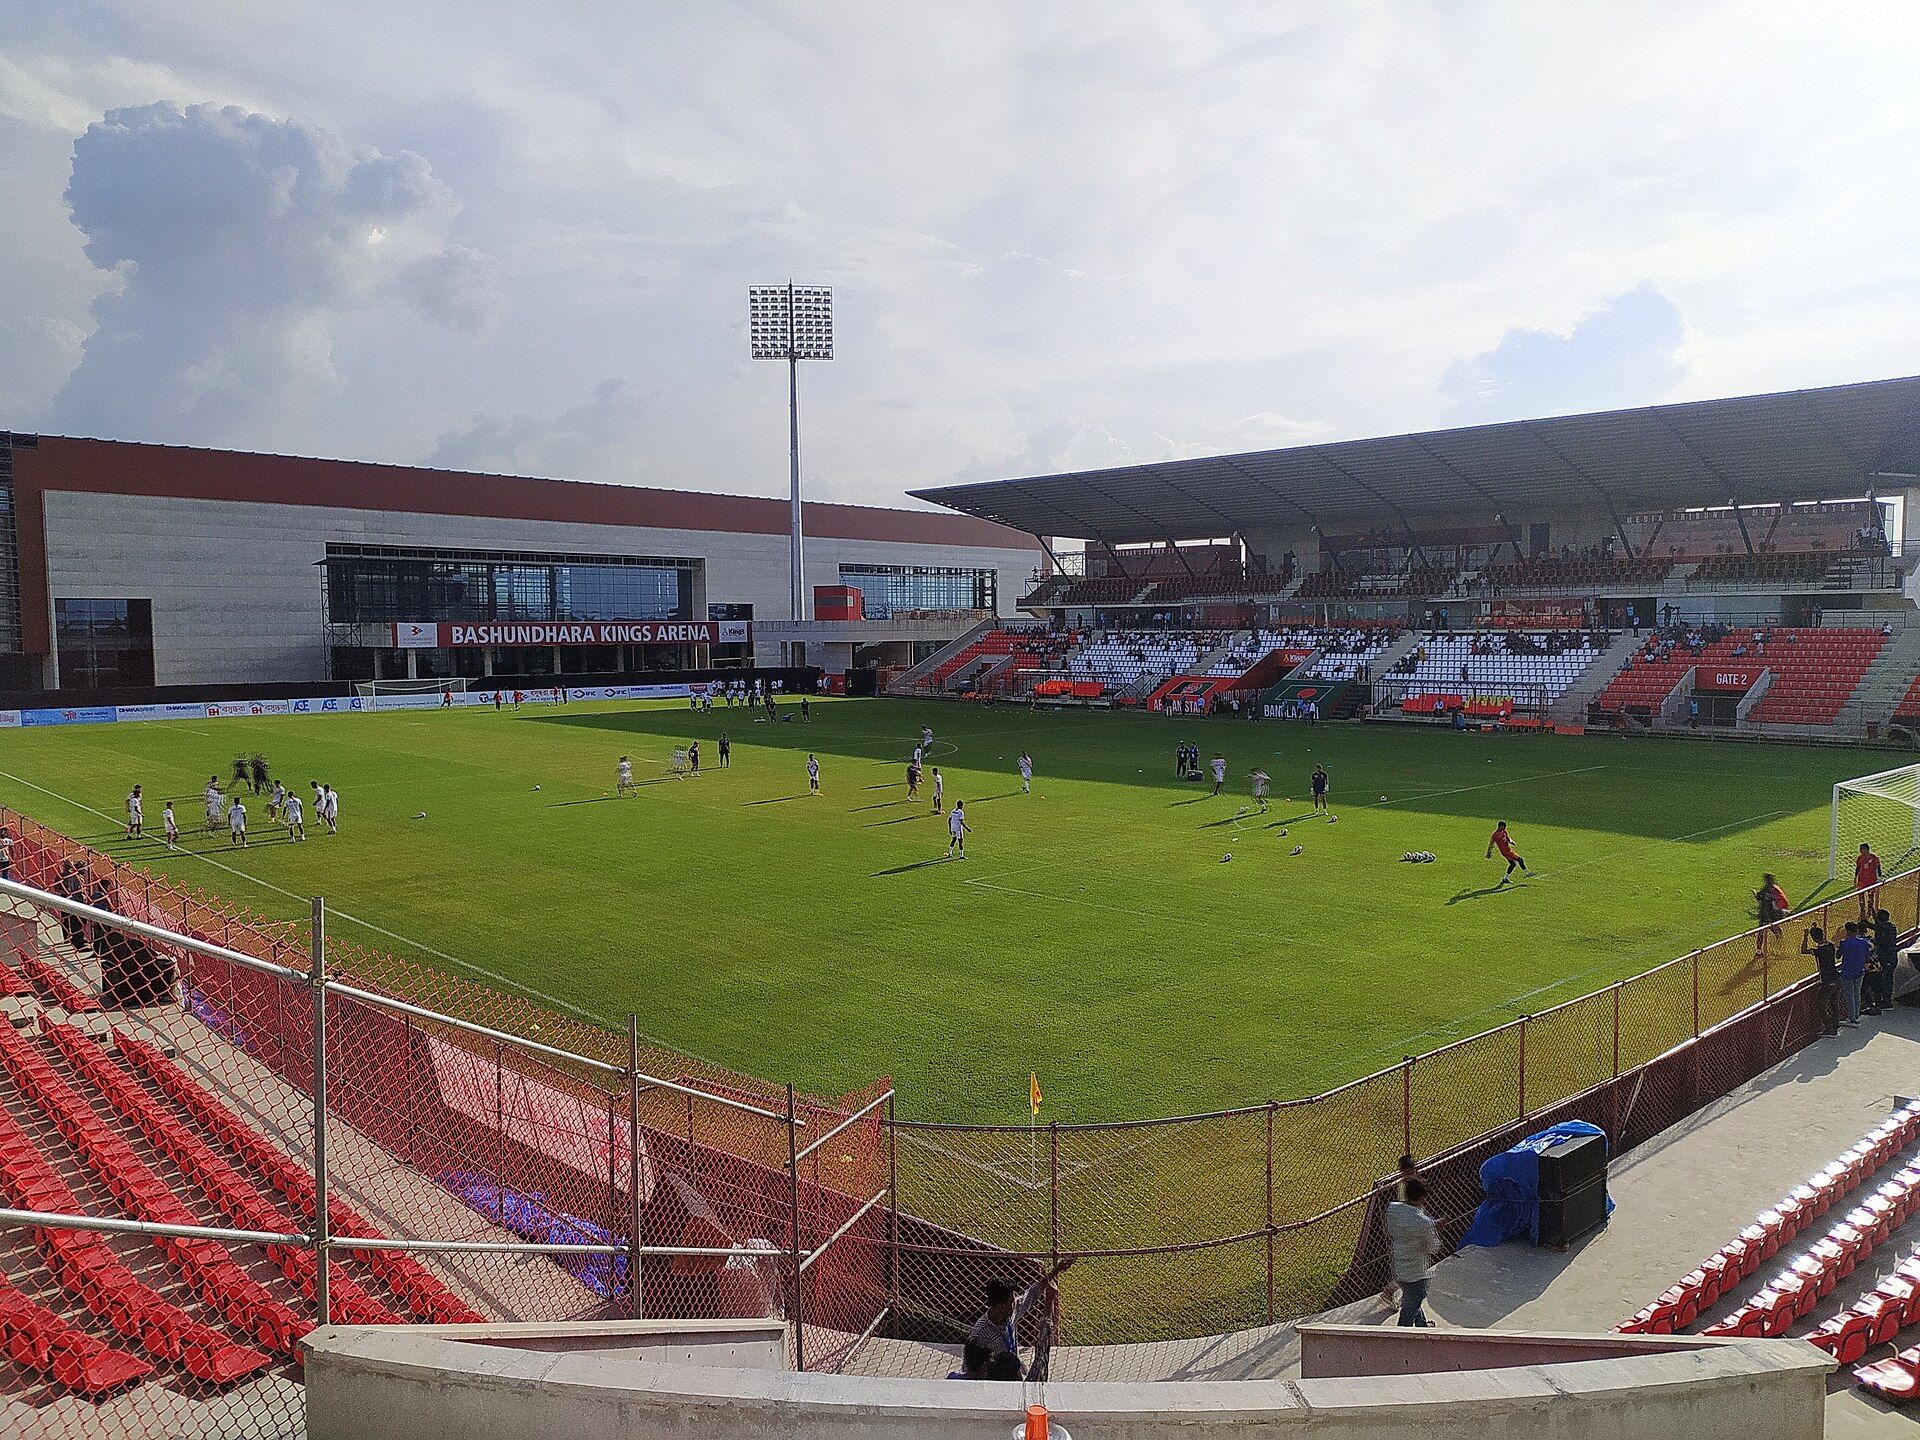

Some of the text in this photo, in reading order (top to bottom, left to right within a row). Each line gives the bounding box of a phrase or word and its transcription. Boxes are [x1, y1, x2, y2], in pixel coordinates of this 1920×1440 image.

[1752, 503, 1856, 516] MEDIA CENTER
[1626, 511, 1726, 523] MEDIA TRIBUNE
[451, 625, 596, 644] BASHUNDHARA
[600, 625, 652, 642] KINGS
[656, 624, 711, 641] ARENA
[1716, 673, 1748, 685] GATE 2
[1153, 699, 1204, 714] AFANSTA
